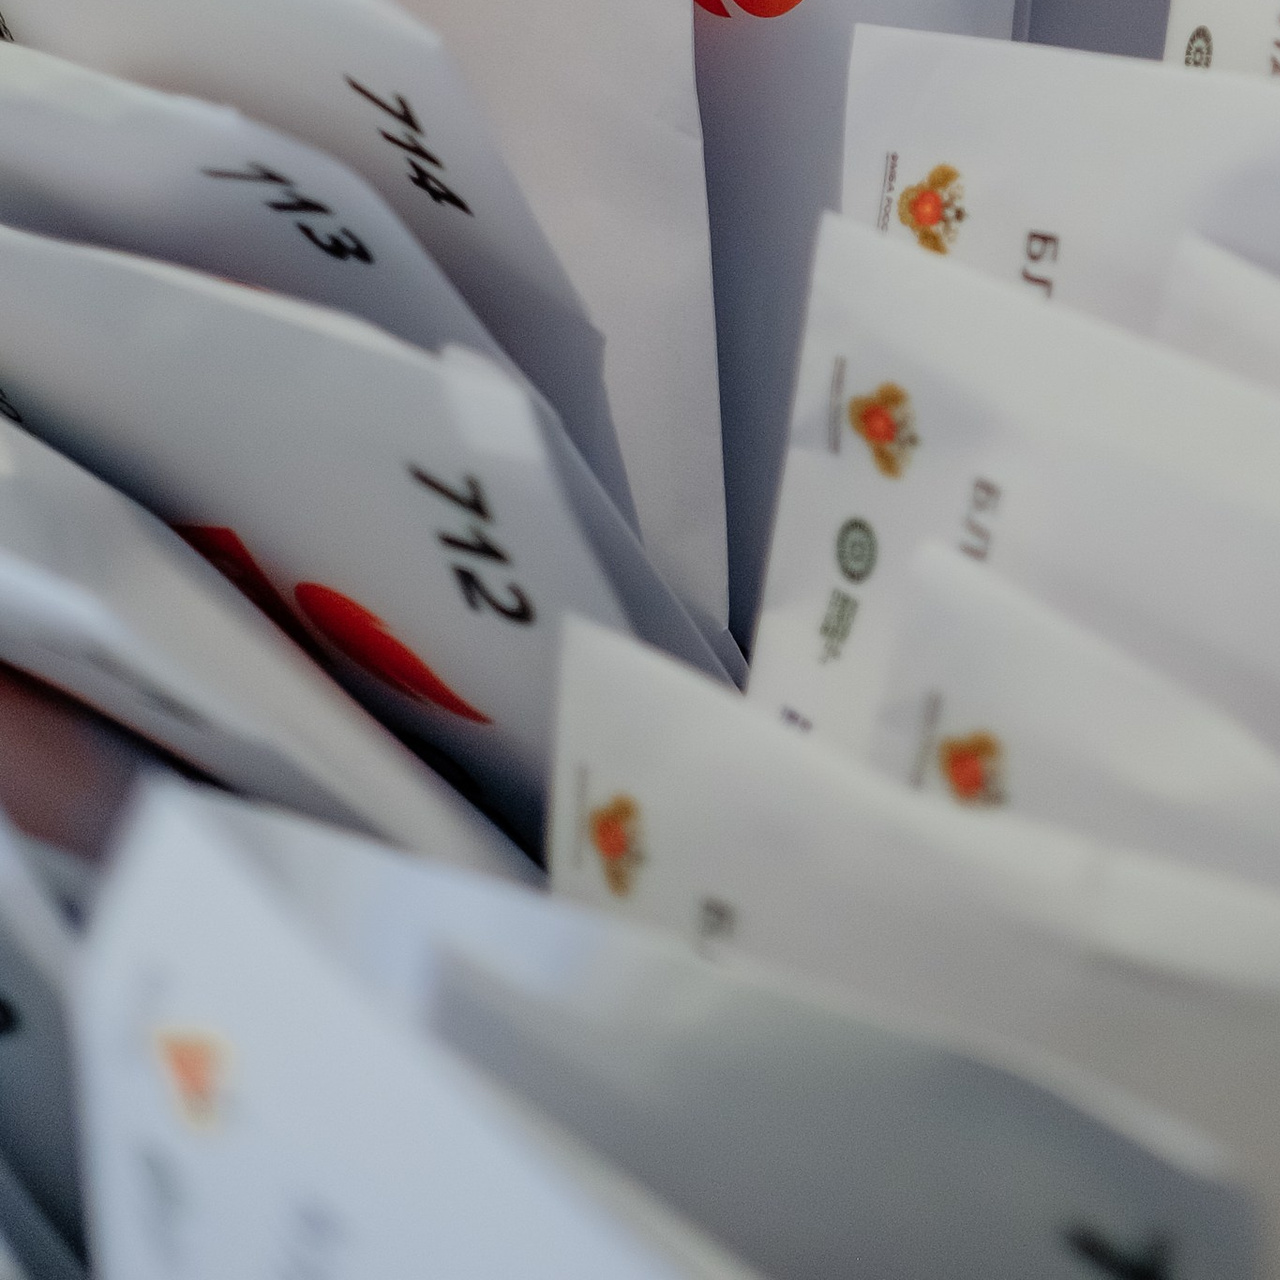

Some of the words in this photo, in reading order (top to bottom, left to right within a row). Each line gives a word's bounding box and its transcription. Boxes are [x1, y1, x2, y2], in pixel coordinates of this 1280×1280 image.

[200, 159, 375, 267] 713
[344, 75, 475, 218] 714
[408, 459, 538, 628] 712
